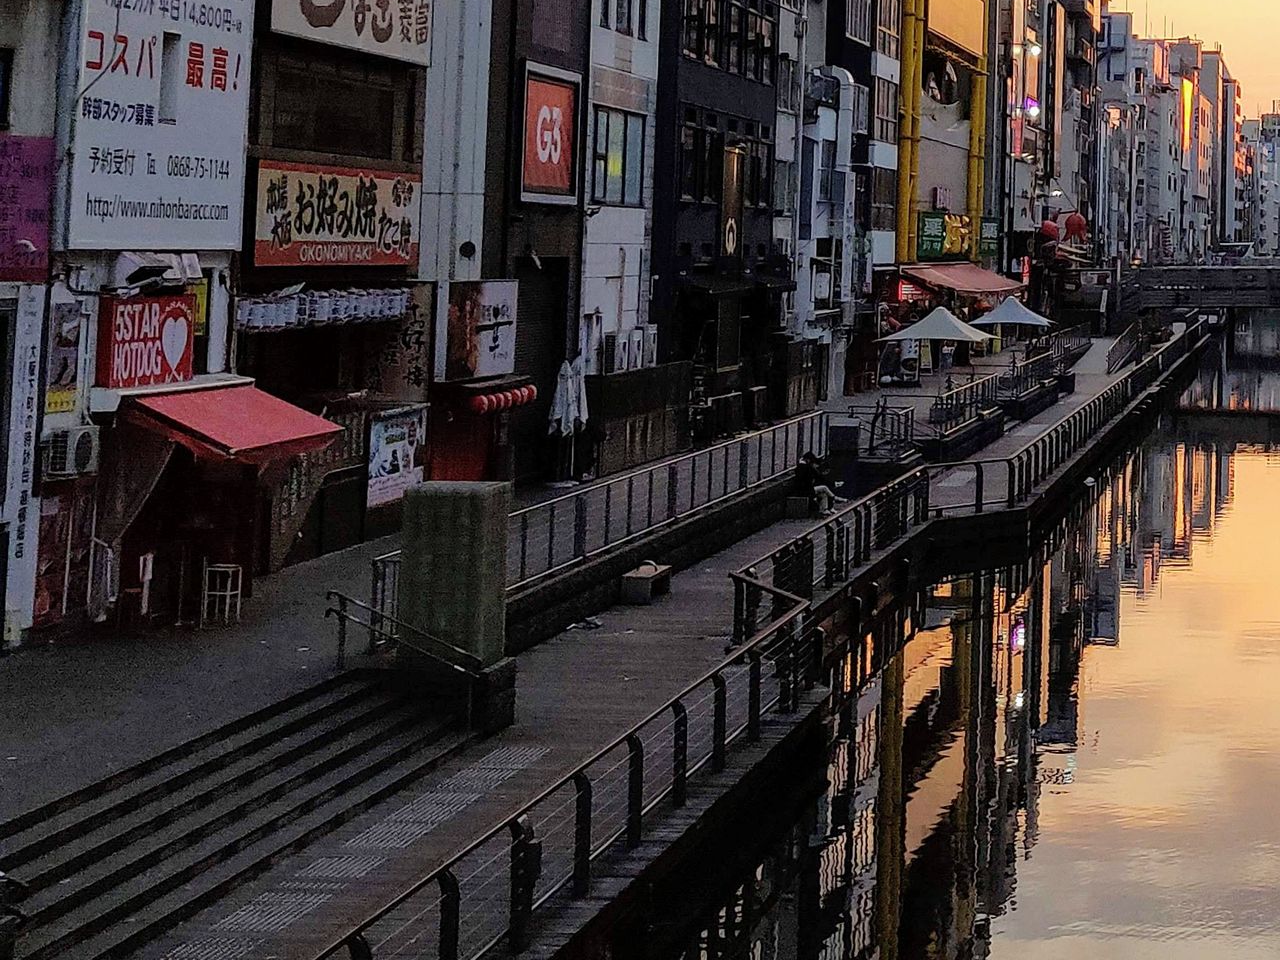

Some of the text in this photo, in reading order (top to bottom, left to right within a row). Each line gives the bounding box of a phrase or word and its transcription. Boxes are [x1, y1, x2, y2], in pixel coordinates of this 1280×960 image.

[85, 29, 157, 80] コスパ
[536, 104, 562, 164] G3
[88, 146, 135, 176] 予約受付
[294, 174, 379, 239] お好み焼
[300, 244, 373, 262] OKONOMIYAKI
[114, 303, 160, 341] 5STAR
[113, 340, 162, 381] HOTDOG
